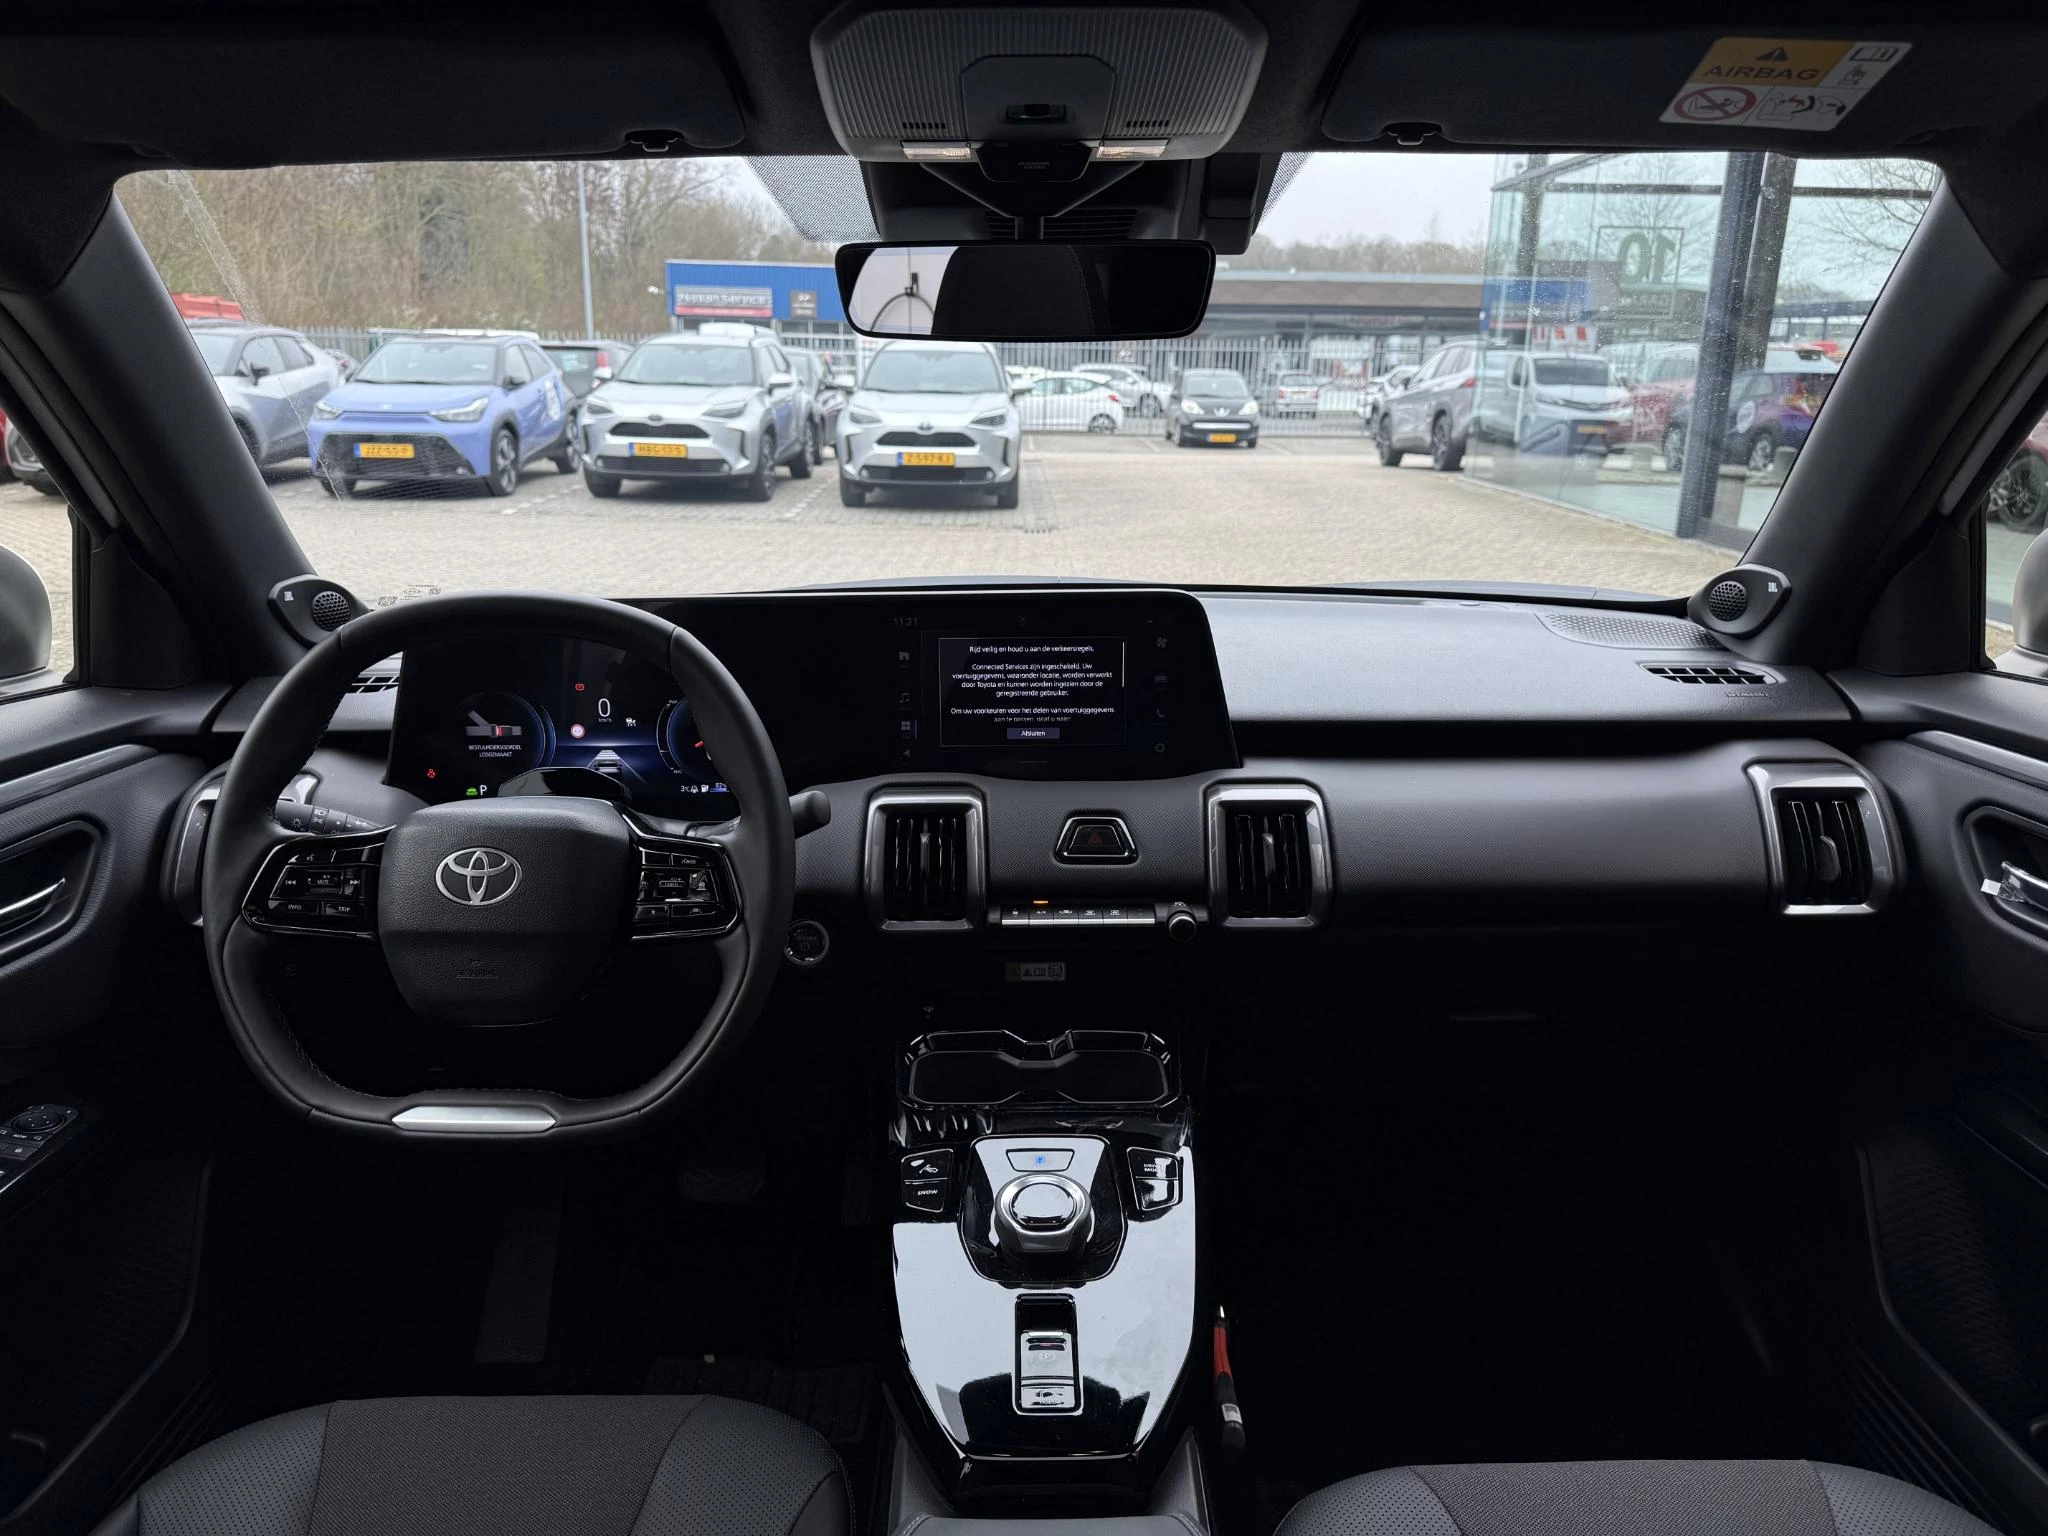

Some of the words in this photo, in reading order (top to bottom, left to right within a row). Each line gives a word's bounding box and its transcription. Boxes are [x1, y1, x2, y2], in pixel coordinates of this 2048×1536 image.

[1702, 65, 1821, 81] AIRBAG
[719, 292, 768, 305] Service
[970, 645, 981, 654] Rijd
[982, 645, 998, 654] veilig
[1008, 645, 1024, 653] houd
[972, 663, 1005, 671] Connected
[1005, 663, 1029, 671] Services
[1030, 663, 1041, 672] zijn
[1087, 671, 1113, 679] verwerkt
[961, 681, 976, 689] door
[977, 681, 997, 690] Toyota
[1054, 680, 1080, 689] ingezien
[1080, 680, 1095, 688] door
[996, 690, 1039, 699] geregistreerde
[598, 698, 611, 717] 0
[974, 707, 1007, 715] voorkeuren
[1008, 707, 1021, 715] voor
[1033, 706, 1050, 714] delen
[1063, 706, 1115, 715] voertuiggegevens
[479, 785, 488, 796] P
[916, 1189, 938, 1197] SNOW
